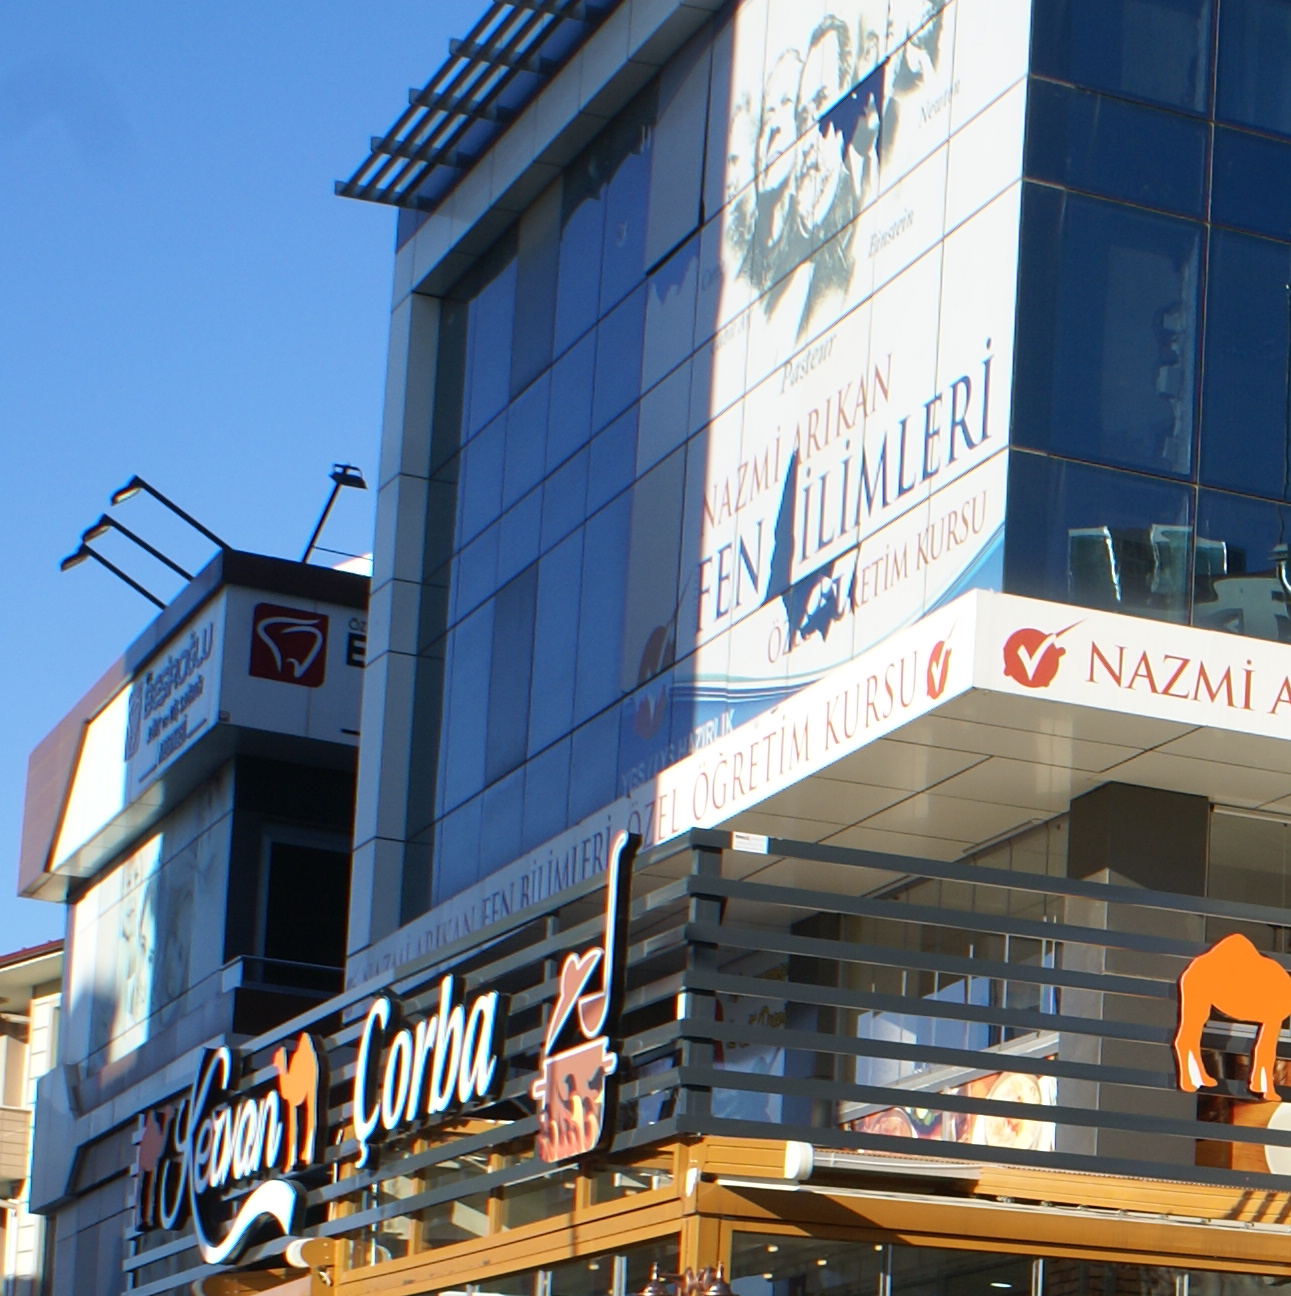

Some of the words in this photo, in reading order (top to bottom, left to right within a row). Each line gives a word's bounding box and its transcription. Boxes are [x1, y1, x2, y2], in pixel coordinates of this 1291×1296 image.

[703, 425, 781, 528] NAZMİ
[795, 353, 892, 465] ARIKAN
[780, 333, 838, 395] Pasteur
[698, 519, 765, 633] FEN
[797, 337, 996, 565] İLİMLERİ
[916, 490, 988, 570] KURSU
[1087, 639, 1254, 711] NAZMİ
[481, 882, 516, 927] FEN
[693, 713, 810, 821] ÖĞRETİM
[825, 651, 918, 752] KURSU
[160, 1045, 297, 1265] Kervan
[353, 974, 499, 1169] Çorba
